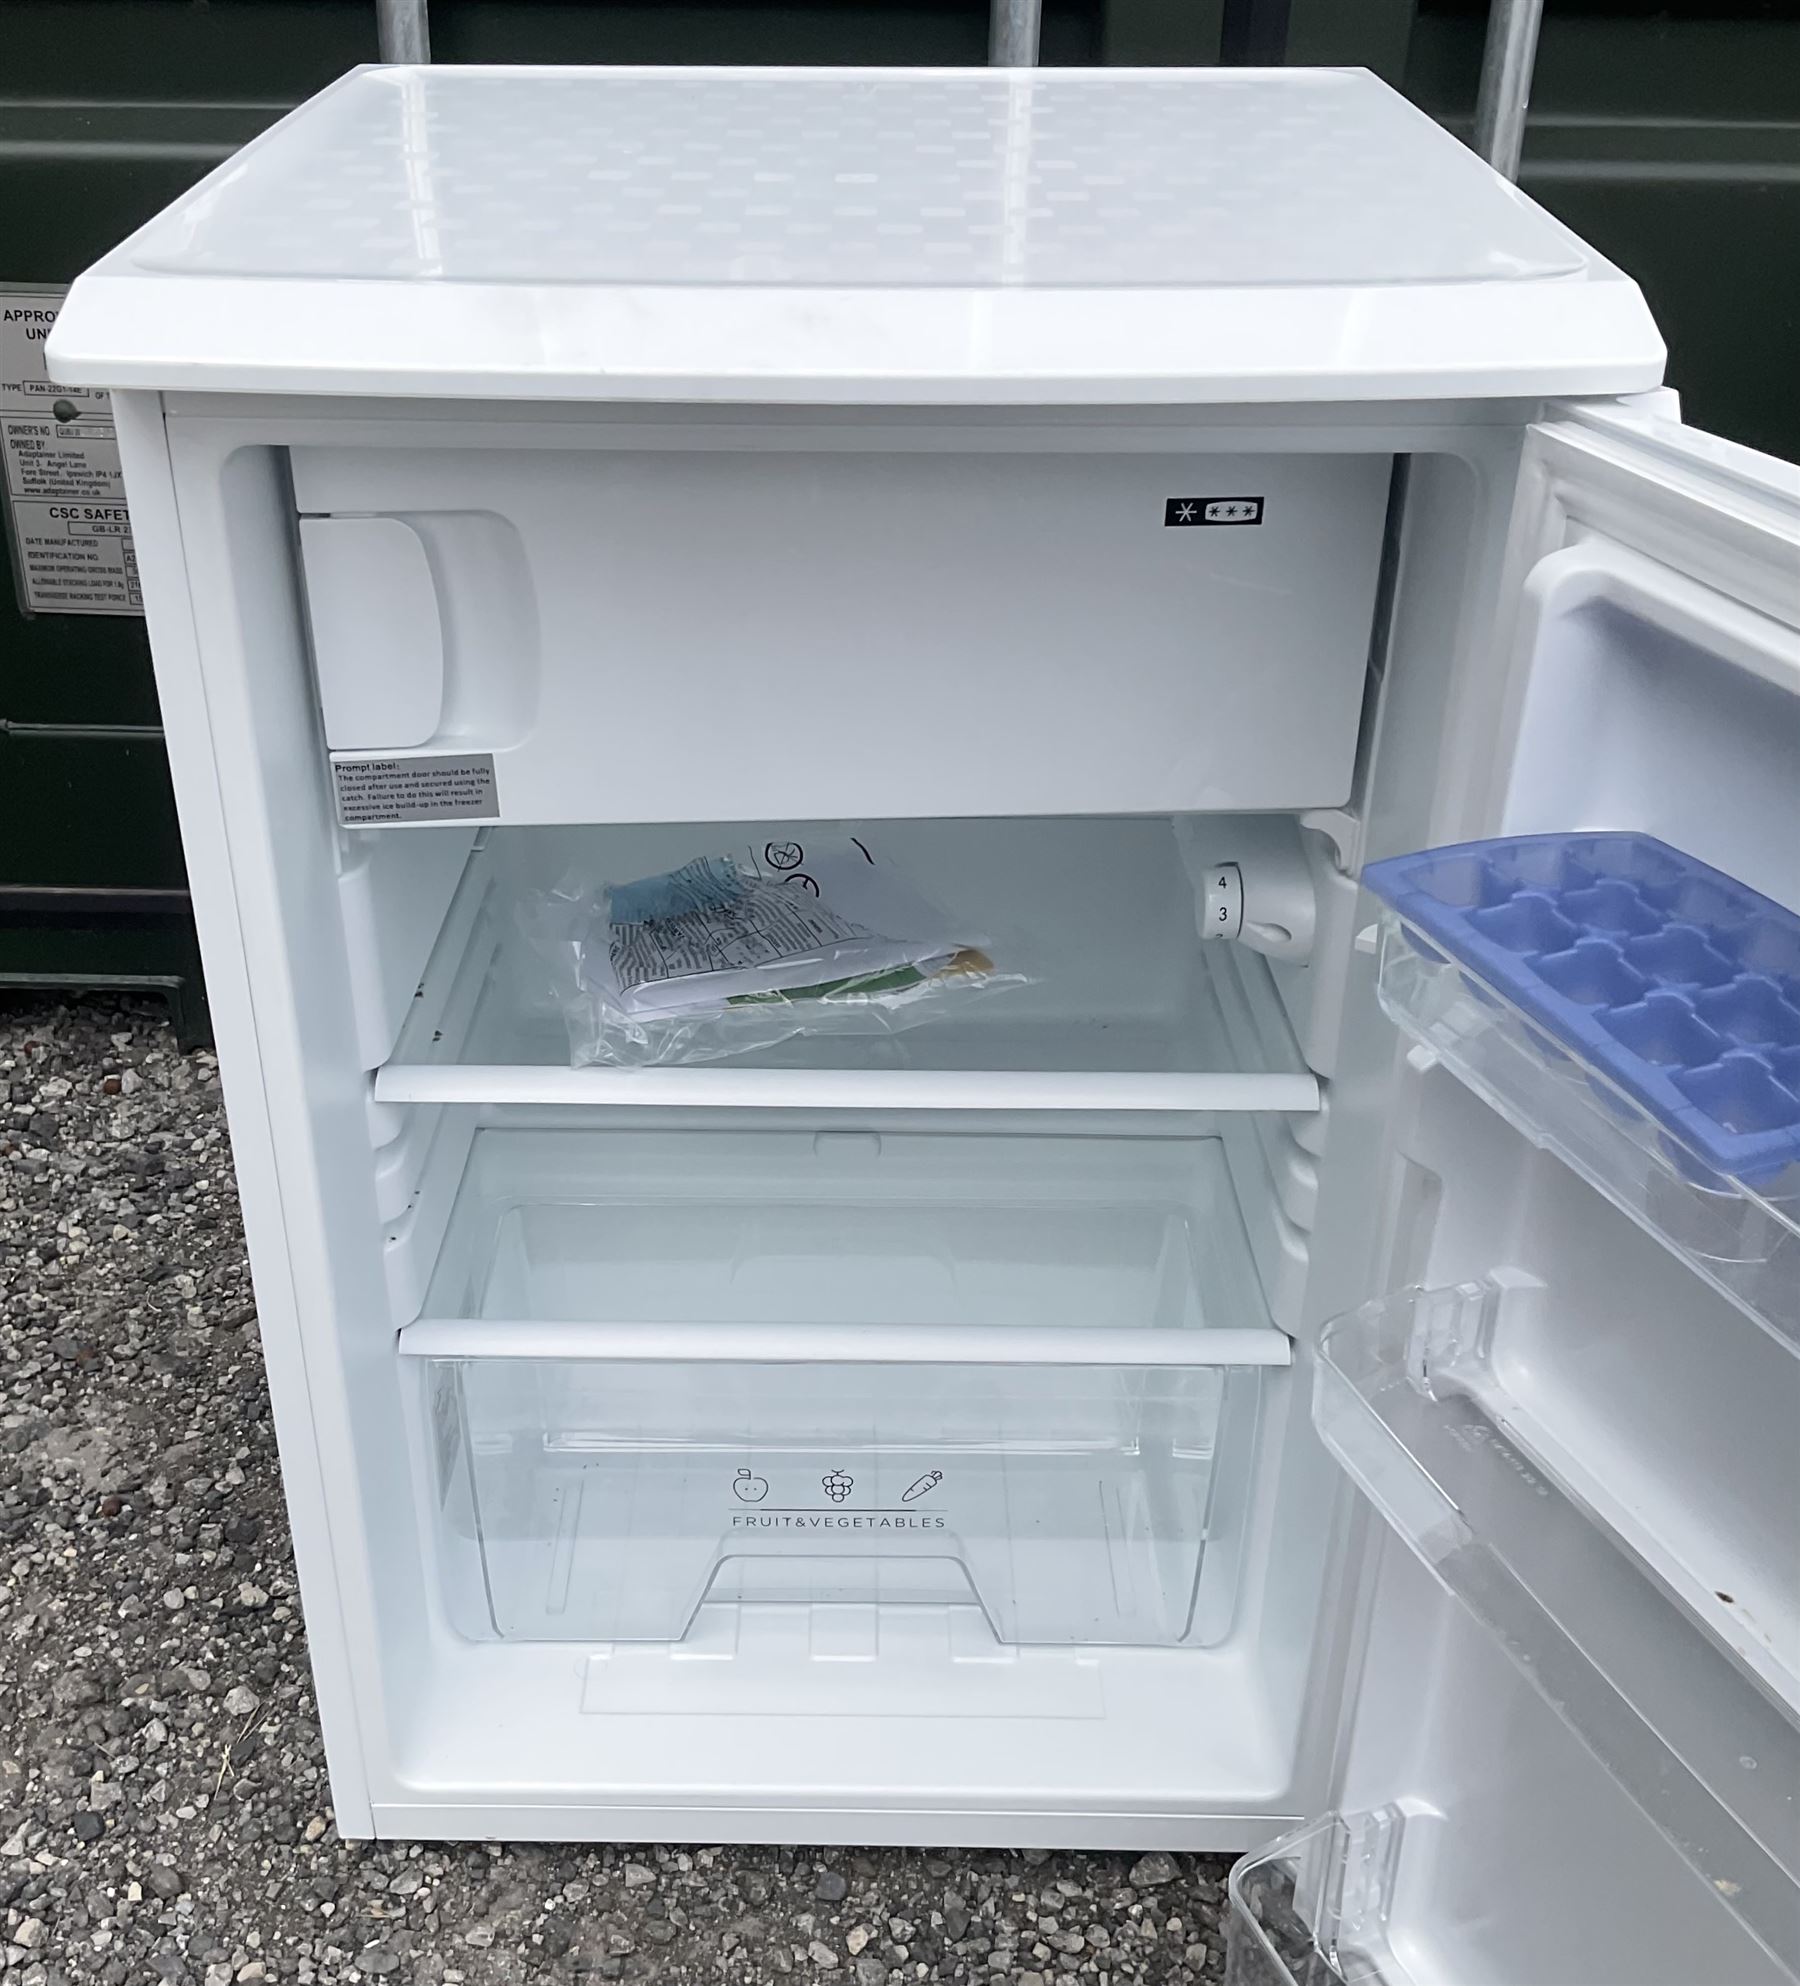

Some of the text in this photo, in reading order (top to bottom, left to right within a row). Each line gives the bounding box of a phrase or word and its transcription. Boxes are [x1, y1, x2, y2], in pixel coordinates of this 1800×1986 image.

[4, 309, 59, 323] APPRO
[2, 383, 22, 392] TYPE
[10, 439, 45, 450] OWNED BY
[58, 451, 85, 459] Limited
[49, 507, 79, 519] CSC
[25, 537, 42, 545] DATE
[28, 551, 85, 560] IDENTIFICATION
[335, 764, 370, 773] Prompt
[338, 774, 354, 782] The
[355, 772, 410, 781] compartment
[432, 769, 459, 777] should
[460, 768, 471, 776] be
[472, 767, 490, 775] fully
[340, 783, 366, 792] closed
[368, 783, 387, 791] after
[404, 781, 419, 789] and
[477, 777, 490, 785] the
[367, 793, 395, 801] Failure
[406, 791, 417, 799] do
[418, 790, 434, 798] this
[435, 789, 450, 797] will
[451, 788, 473, 796] result
[395, 801, 430, 810] build-up
[454, 798, 483, 806] freezer
[1219, 876, 1227, 889] 4
[1219, 906, 1227, 922] 3
[732, 1516, 946, 1529] FRUIT&VEGETABLES
